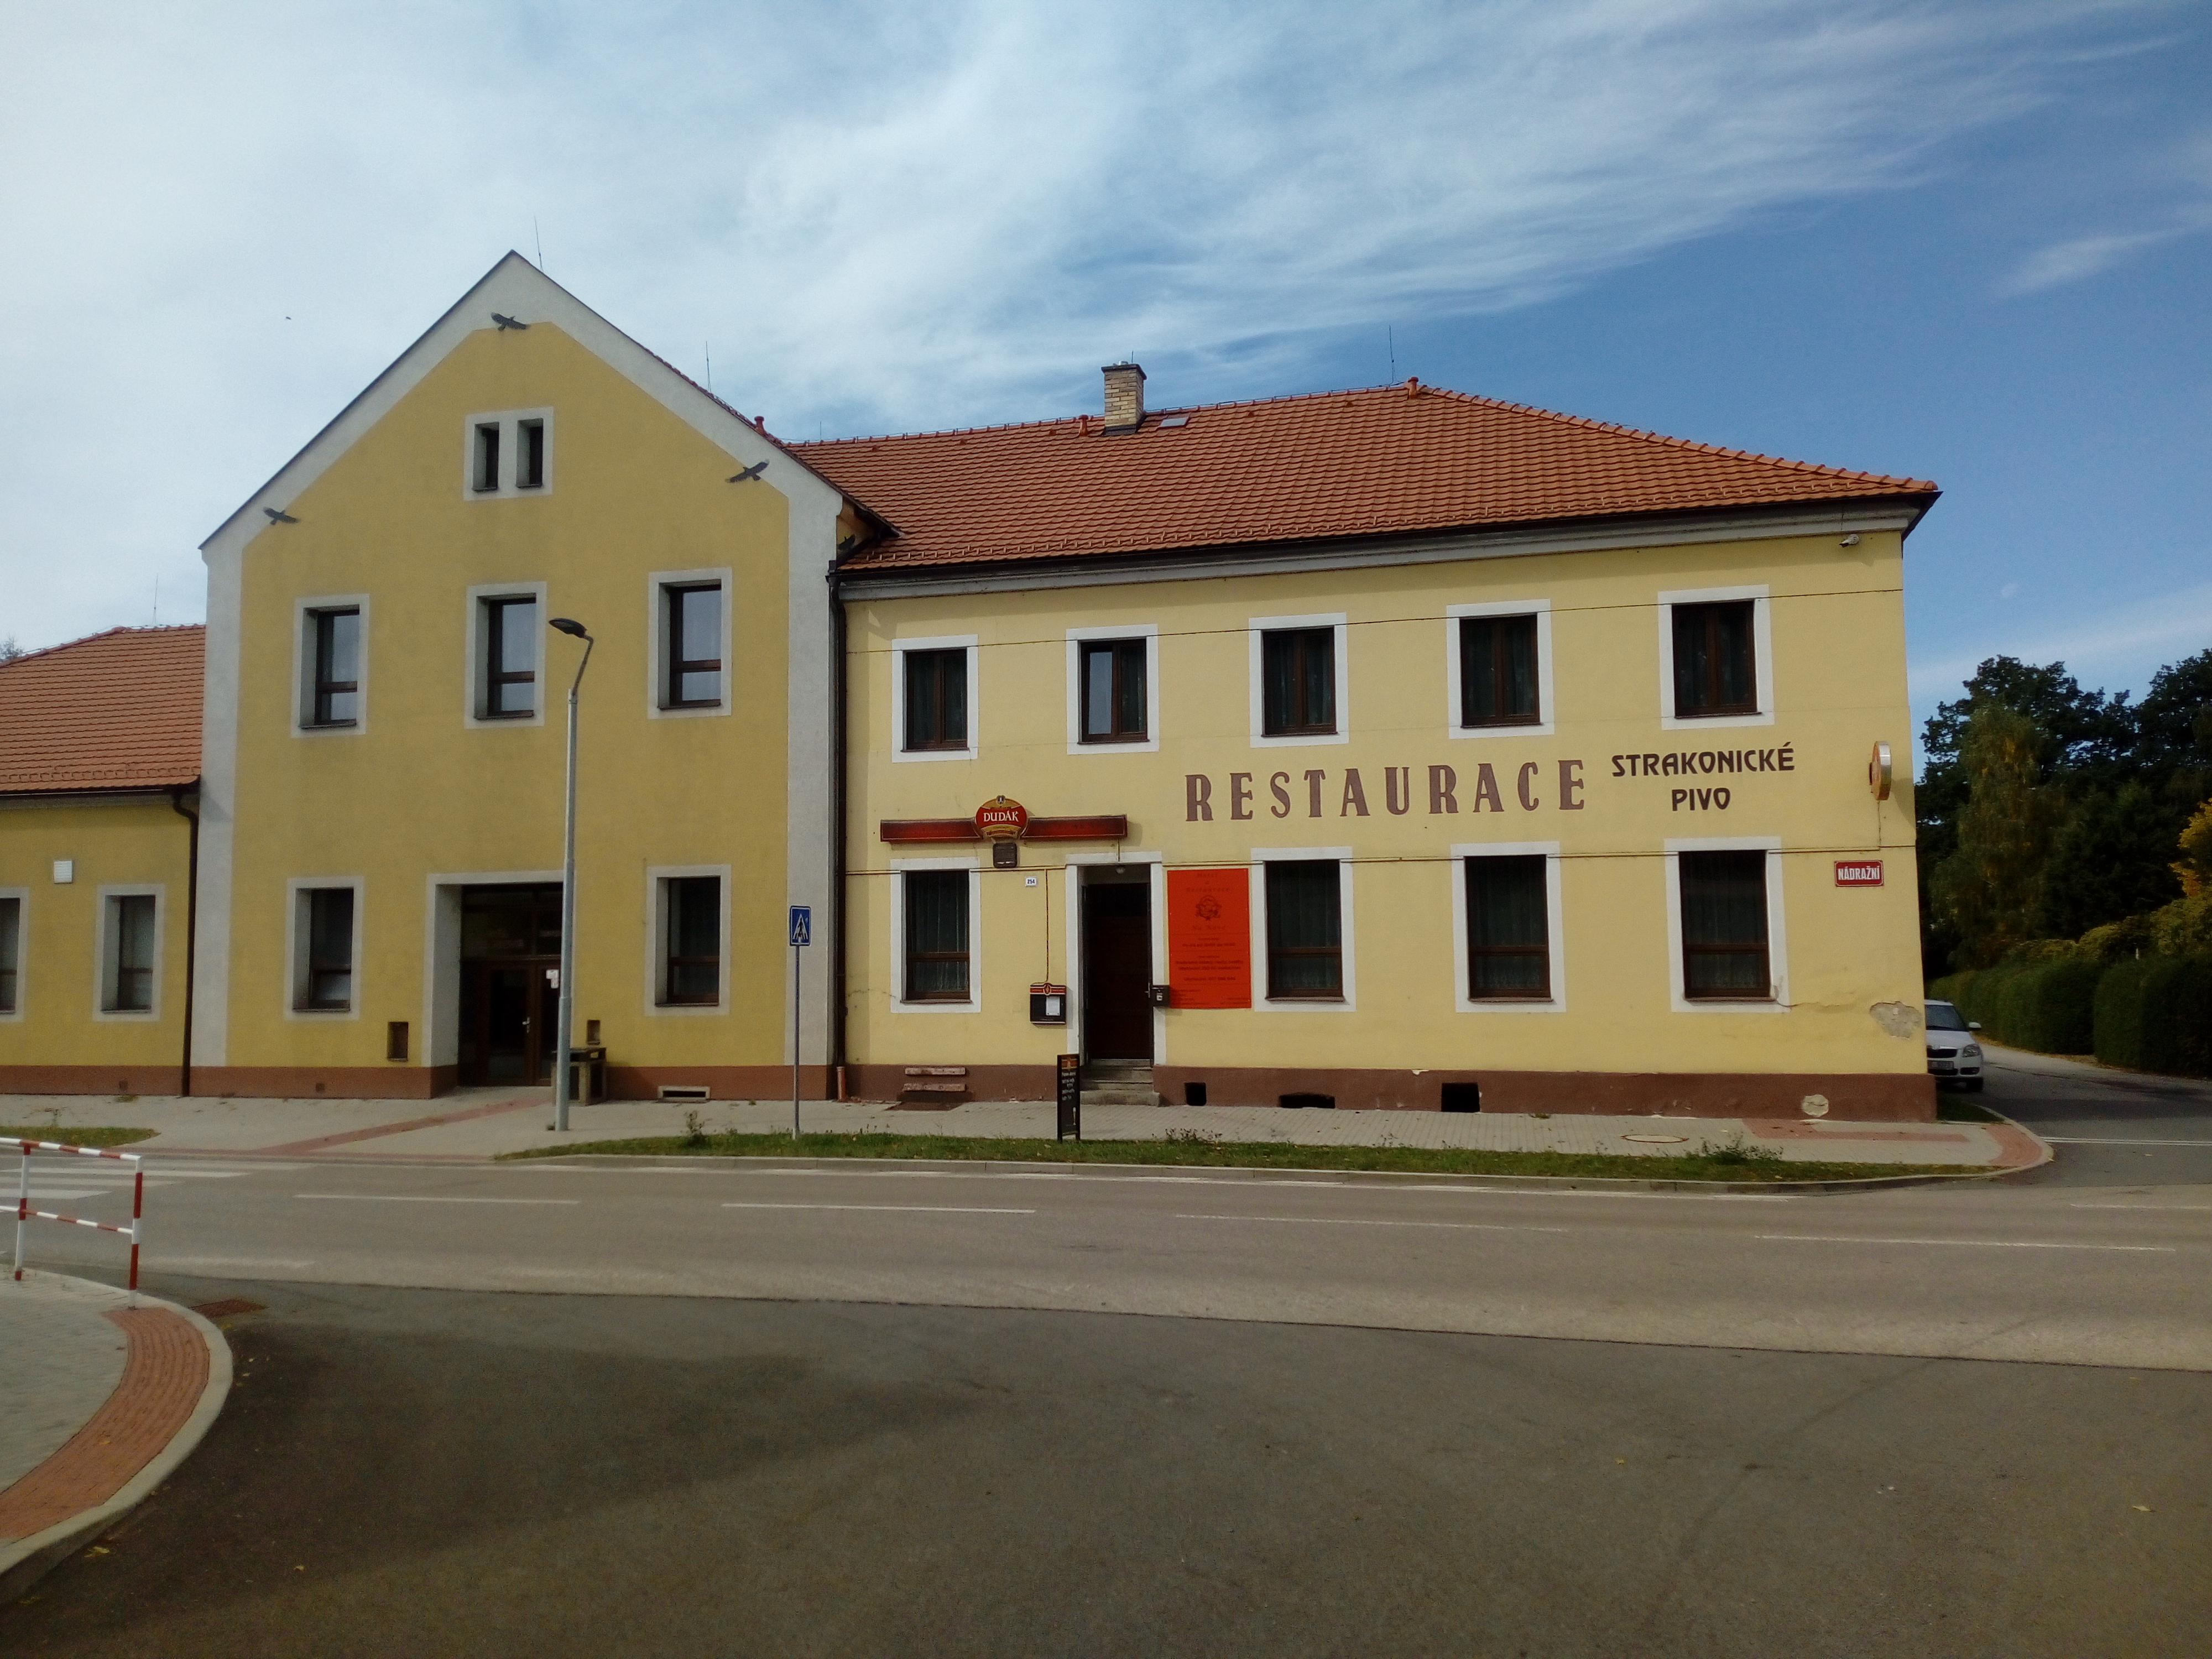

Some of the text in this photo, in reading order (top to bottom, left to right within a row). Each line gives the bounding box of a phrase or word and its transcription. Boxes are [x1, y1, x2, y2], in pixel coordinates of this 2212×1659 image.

[1611, 742, 1795, 777] STRAKONICKÉ
[1185, 759, 1584, 822] RESTAURACE
[1672, 787, 1730, 811] PIVO
[983, 810, 1019, 822] DUDÁK
[1838, 865, 1880, 880] NÁDRAŽNÍ
